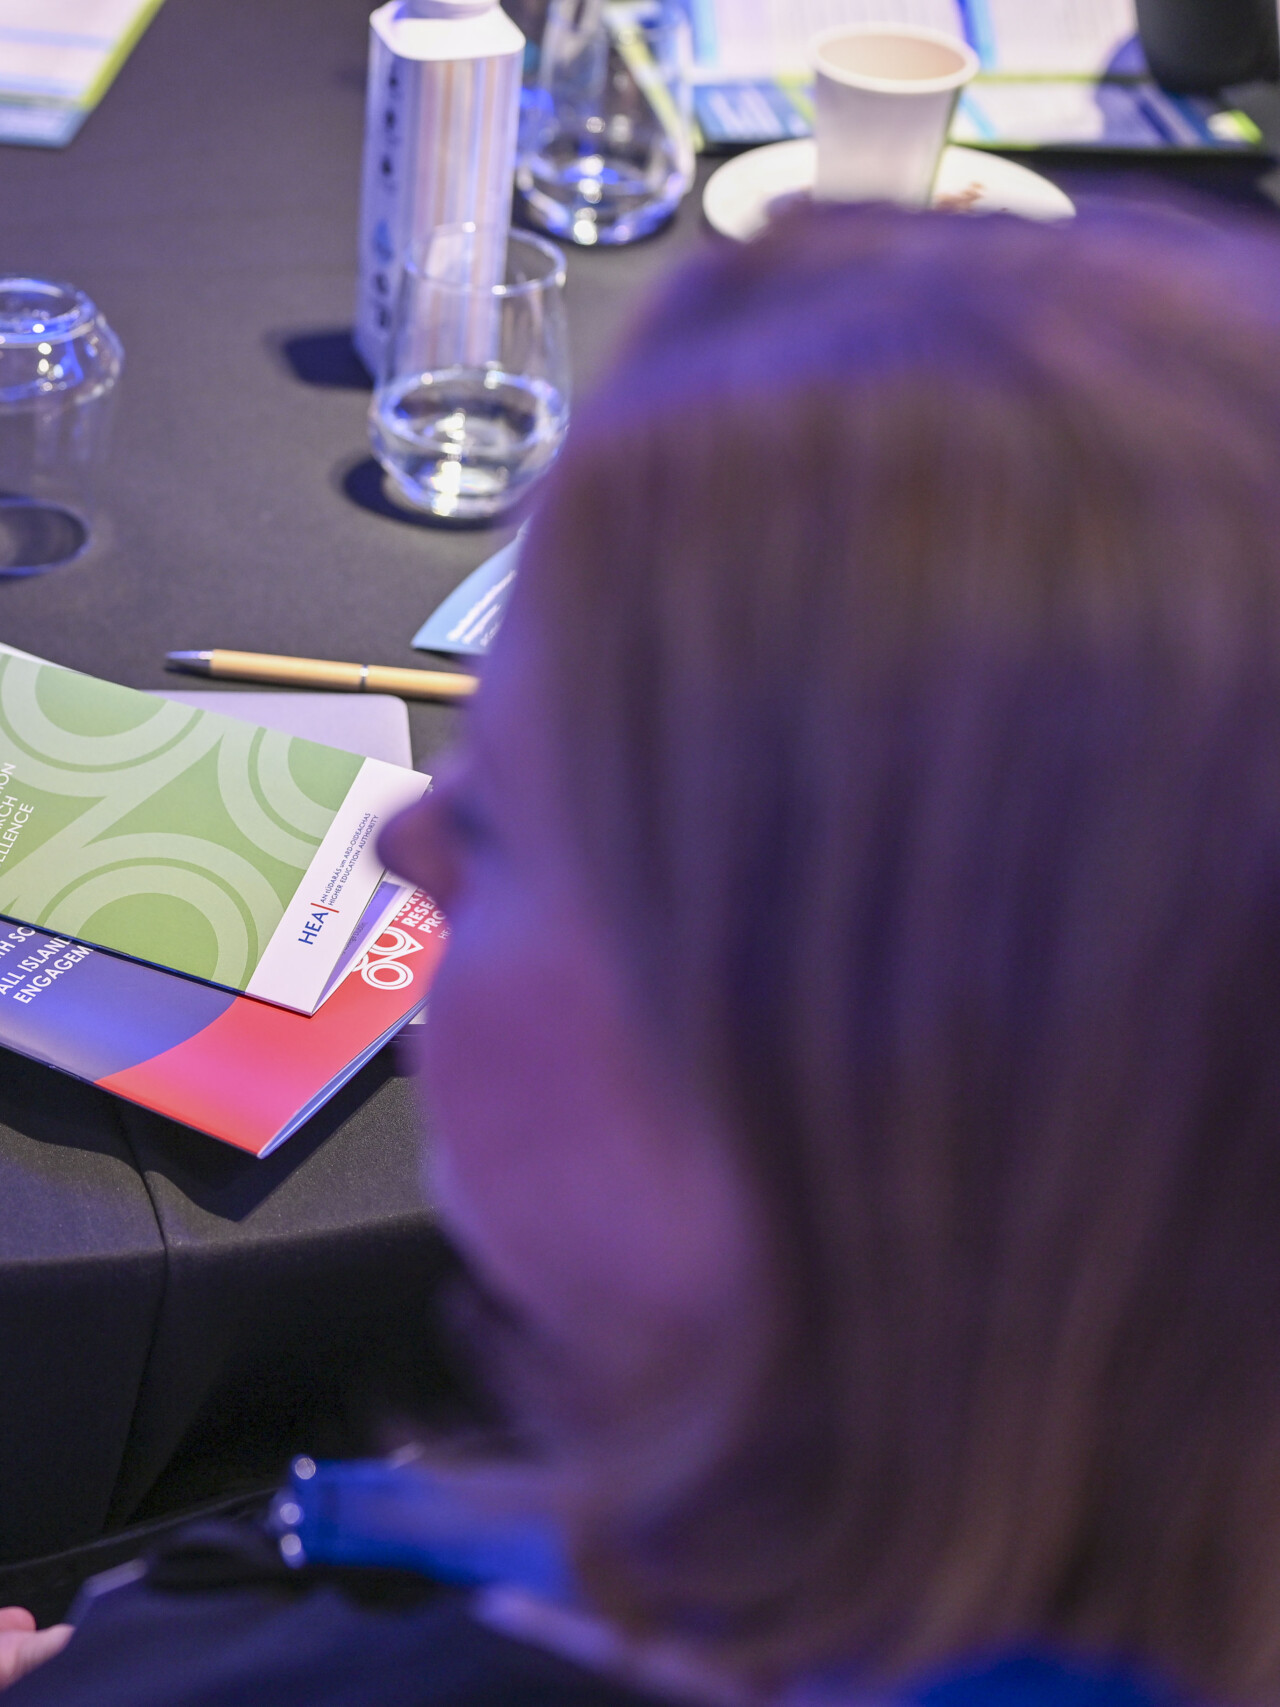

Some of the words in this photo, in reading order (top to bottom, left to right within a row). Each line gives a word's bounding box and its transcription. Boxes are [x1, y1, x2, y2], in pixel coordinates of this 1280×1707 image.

[320, 893, 329, 904] AN
[344, 813, 371, 860] ARD-OIDEACHAS
[328, 884, 344, 906] HIGHER
[340, 849, 360, 884] EDUCATION
[359, 815, 380, 850] AUTHORITY
[298, 912, 329, 945] HEA
[13, 945, 94, 1004] ENGAGEM
